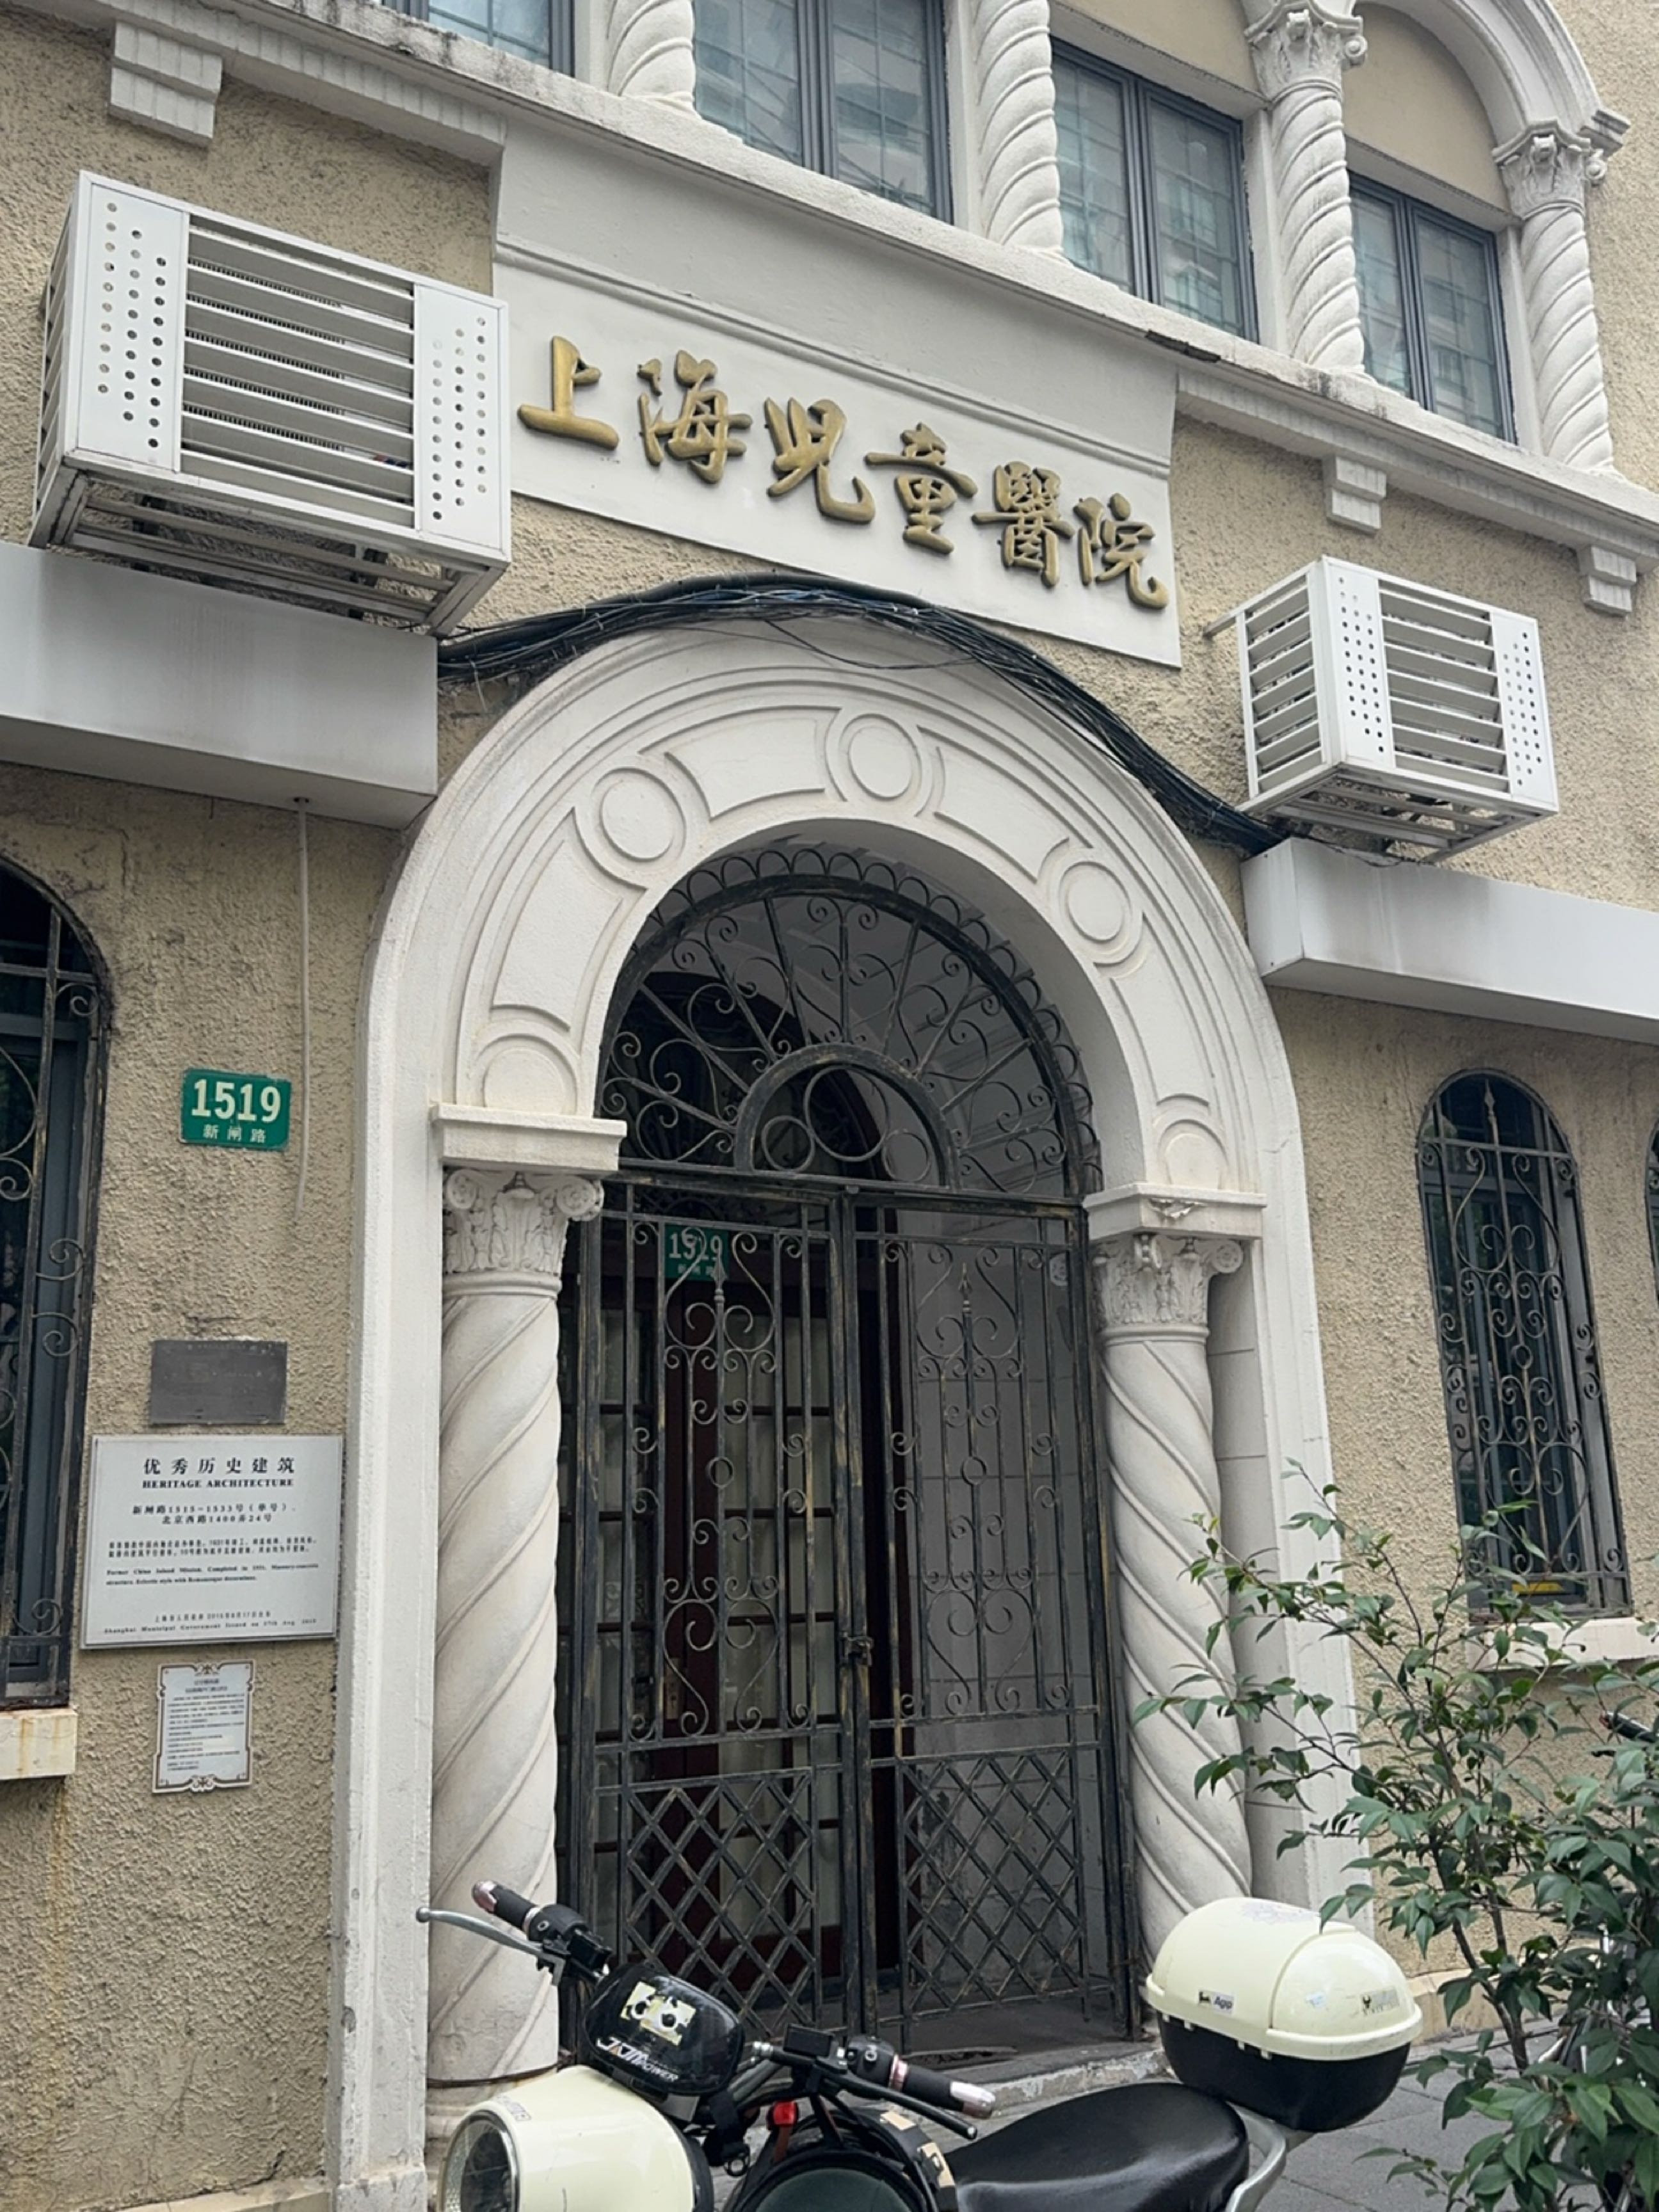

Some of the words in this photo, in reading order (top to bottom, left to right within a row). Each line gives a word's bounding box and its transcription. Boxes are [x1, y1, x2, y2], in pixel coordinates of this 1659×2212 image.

[191, 1079, 281, 1122] 1519
[203, 1124, 267, 1143] 新闸路
[143, 1457, 294, 1475] 优秀历史建筑
[142, 1480, 202, 1489] HERITAGE
[206, 1479, 294, 1488] ARCHITECTURE
